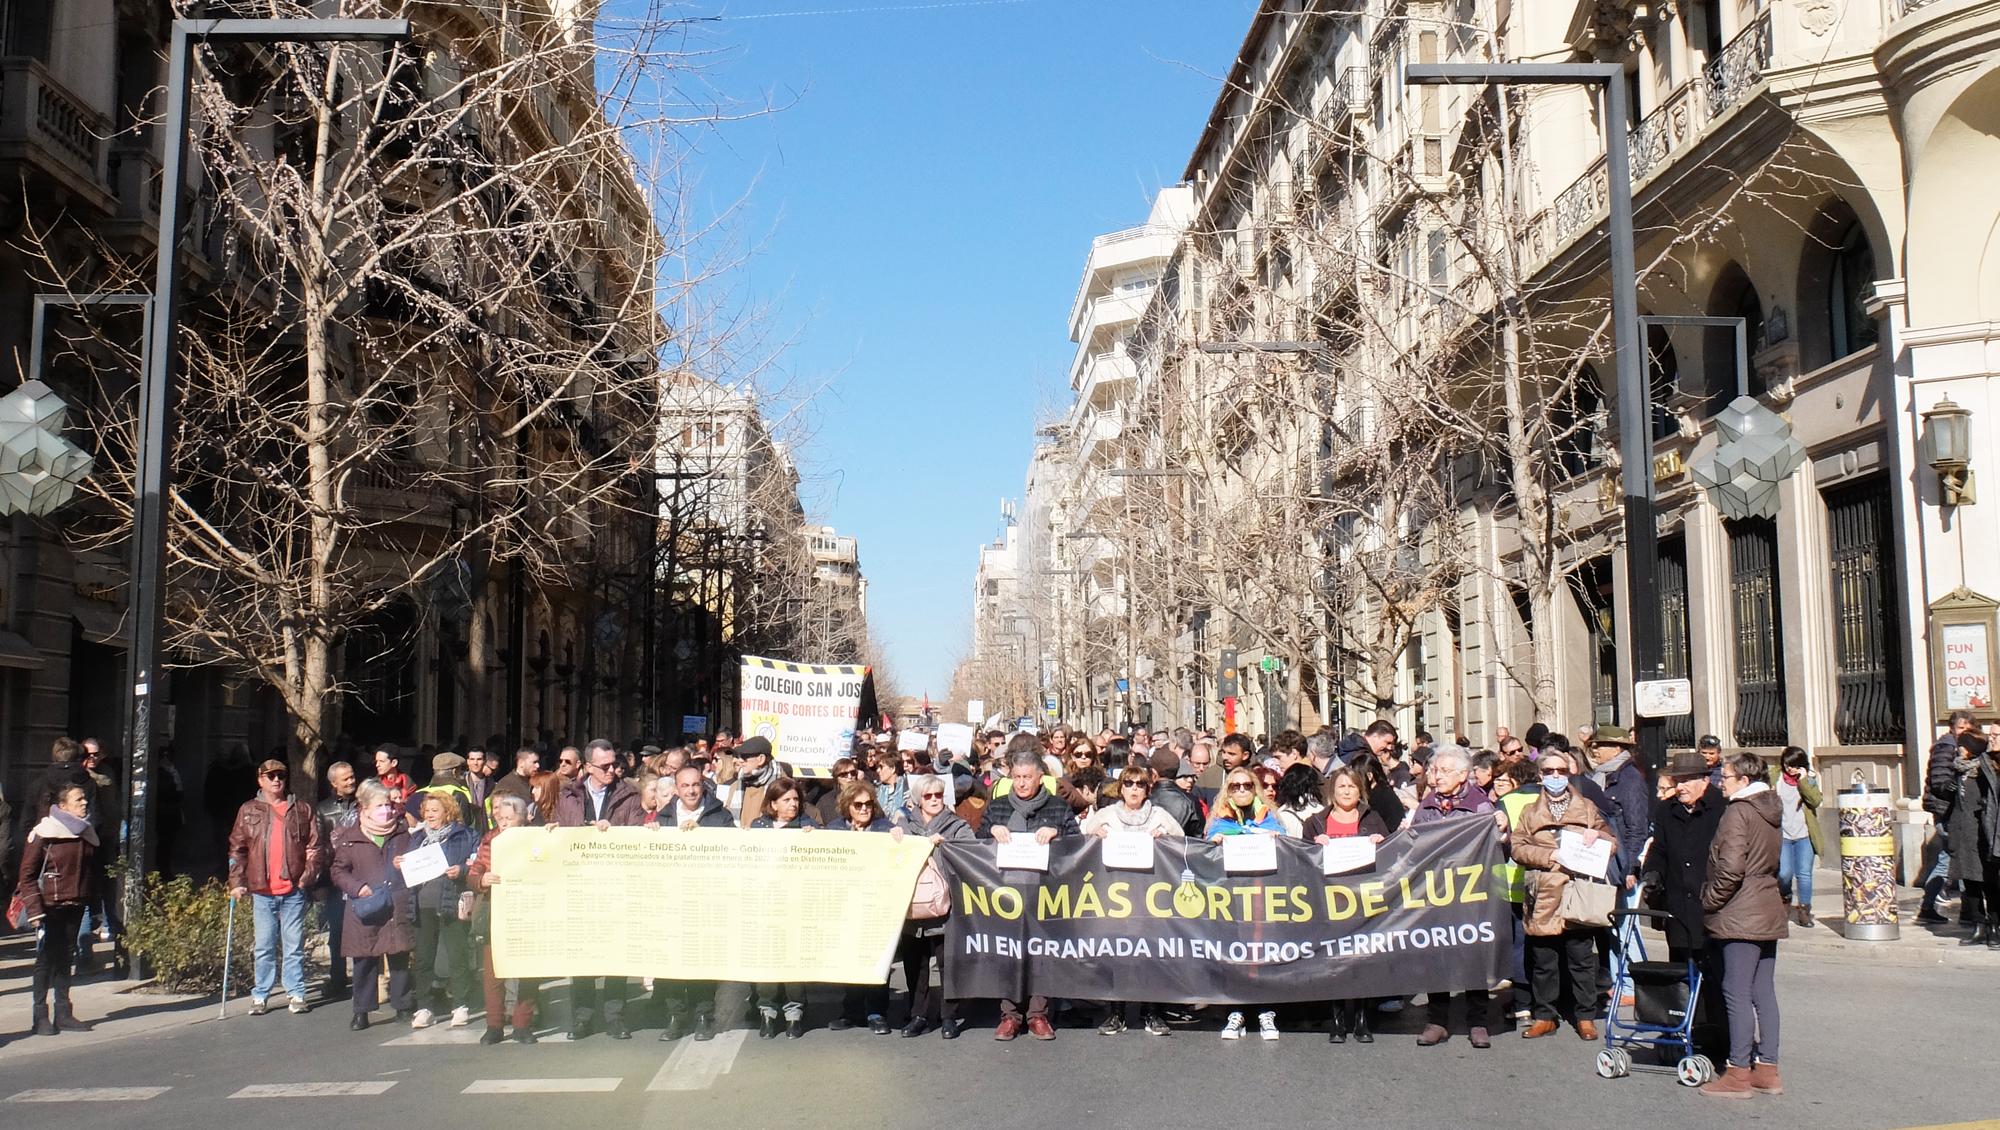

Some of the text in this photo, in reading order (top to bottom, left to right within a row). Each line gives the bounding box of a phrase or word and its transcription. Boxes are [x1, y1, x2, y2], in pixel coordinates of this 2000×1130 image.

[1947, 643, 1973, 653] FUN
[1948, 660, 1967, 670] DA
[755, 675, 861, 698] COLEGIO SAN JOS
[741, 697, 860, 719] ONTRA LOS CORTES DE LU
[786, 735, 818, 743] NO HAY
[609, 842, 641, 851] Cortes!
[649, 843, 687, 851] ENDESA
[689, 844, 729, 854] culpable
[790, 845, 859, 856] Responsables.
[673, 853, 710, 861] plataforma
[800, 855, 826, 863] Distrito
[961, 864, 1488, 922] NO MÁS CORTES DE LUZ
[966, 921, 1496, 963] NI EN GRANADA NI EN OTROS TERRITORIOS
